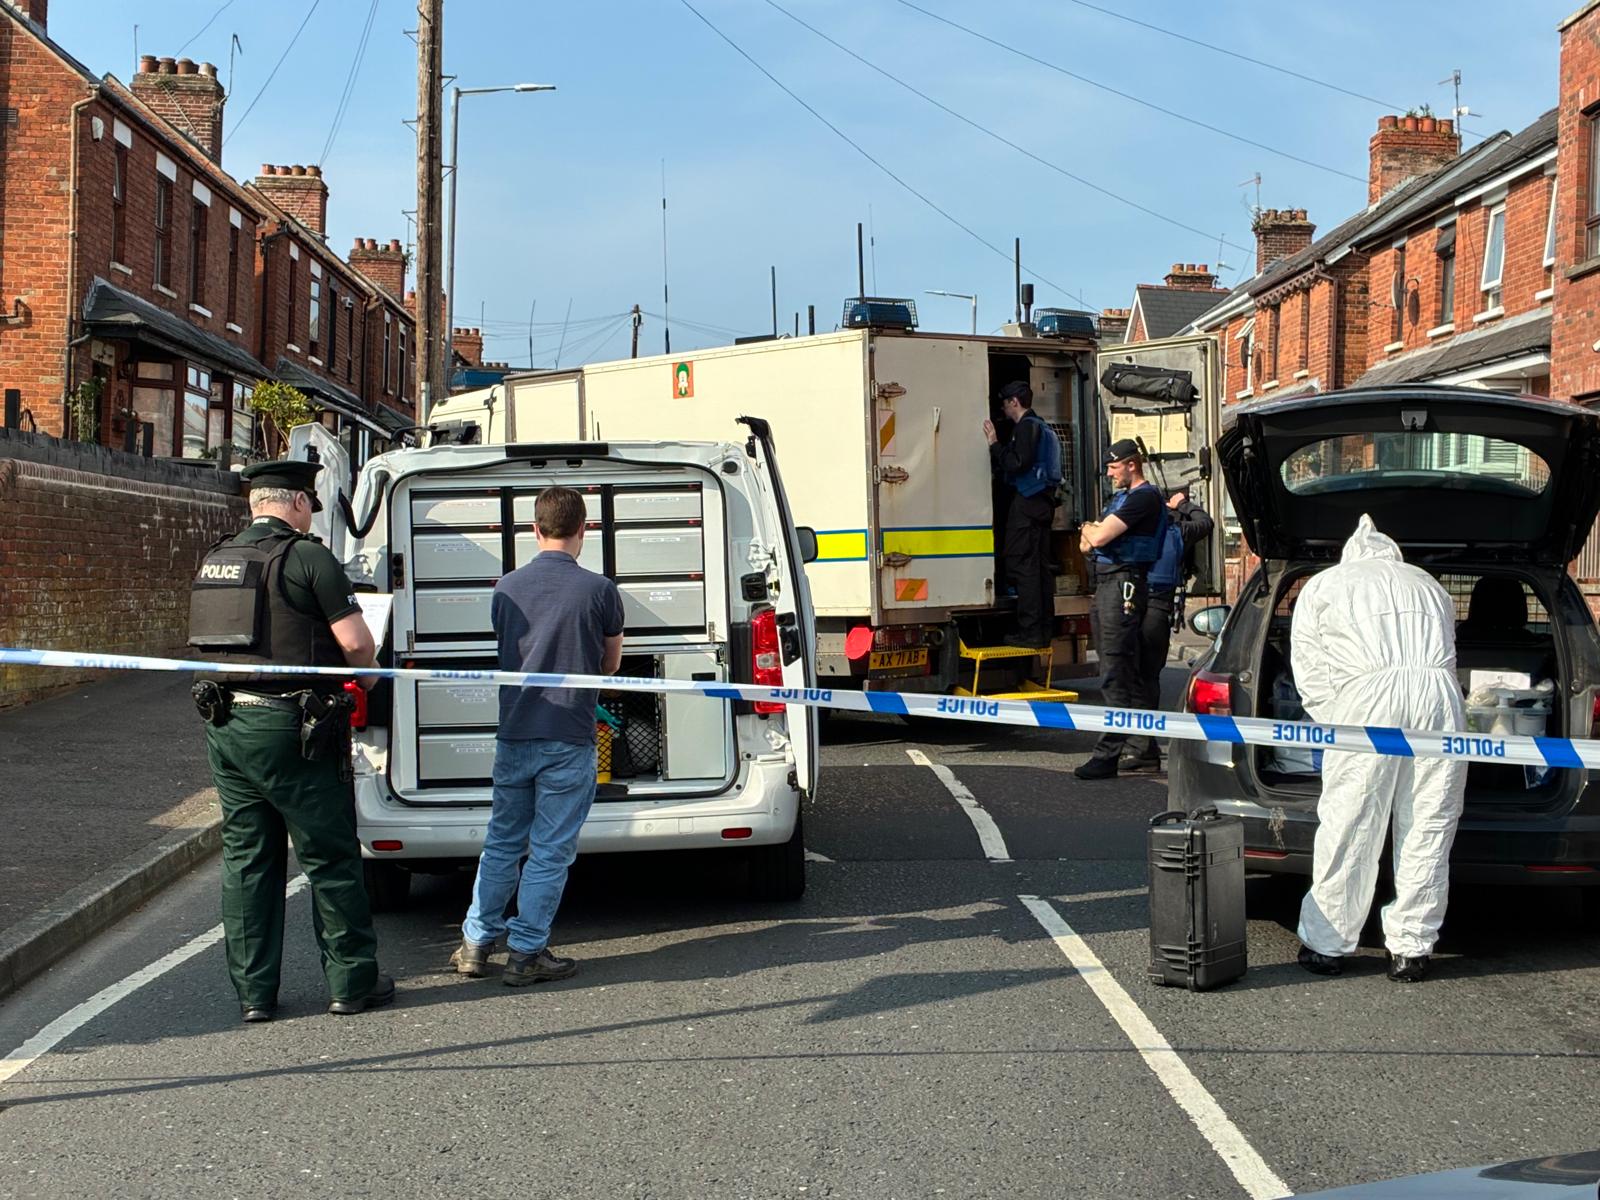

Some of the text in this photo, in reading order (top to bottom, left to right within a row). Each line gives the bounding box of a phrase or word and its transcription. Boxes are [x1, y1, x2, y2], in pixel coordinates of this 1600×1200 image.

[200, 564, 241, 579] POLICE
[879, 653, 894, 667] AX
[936, 697, 1000, 717] POLICE
[1103, 709, 1167, 731] POLICE
[1272, 723, 1336, 745] POLICE
[1442, 735, 1506, 758] POLICE
